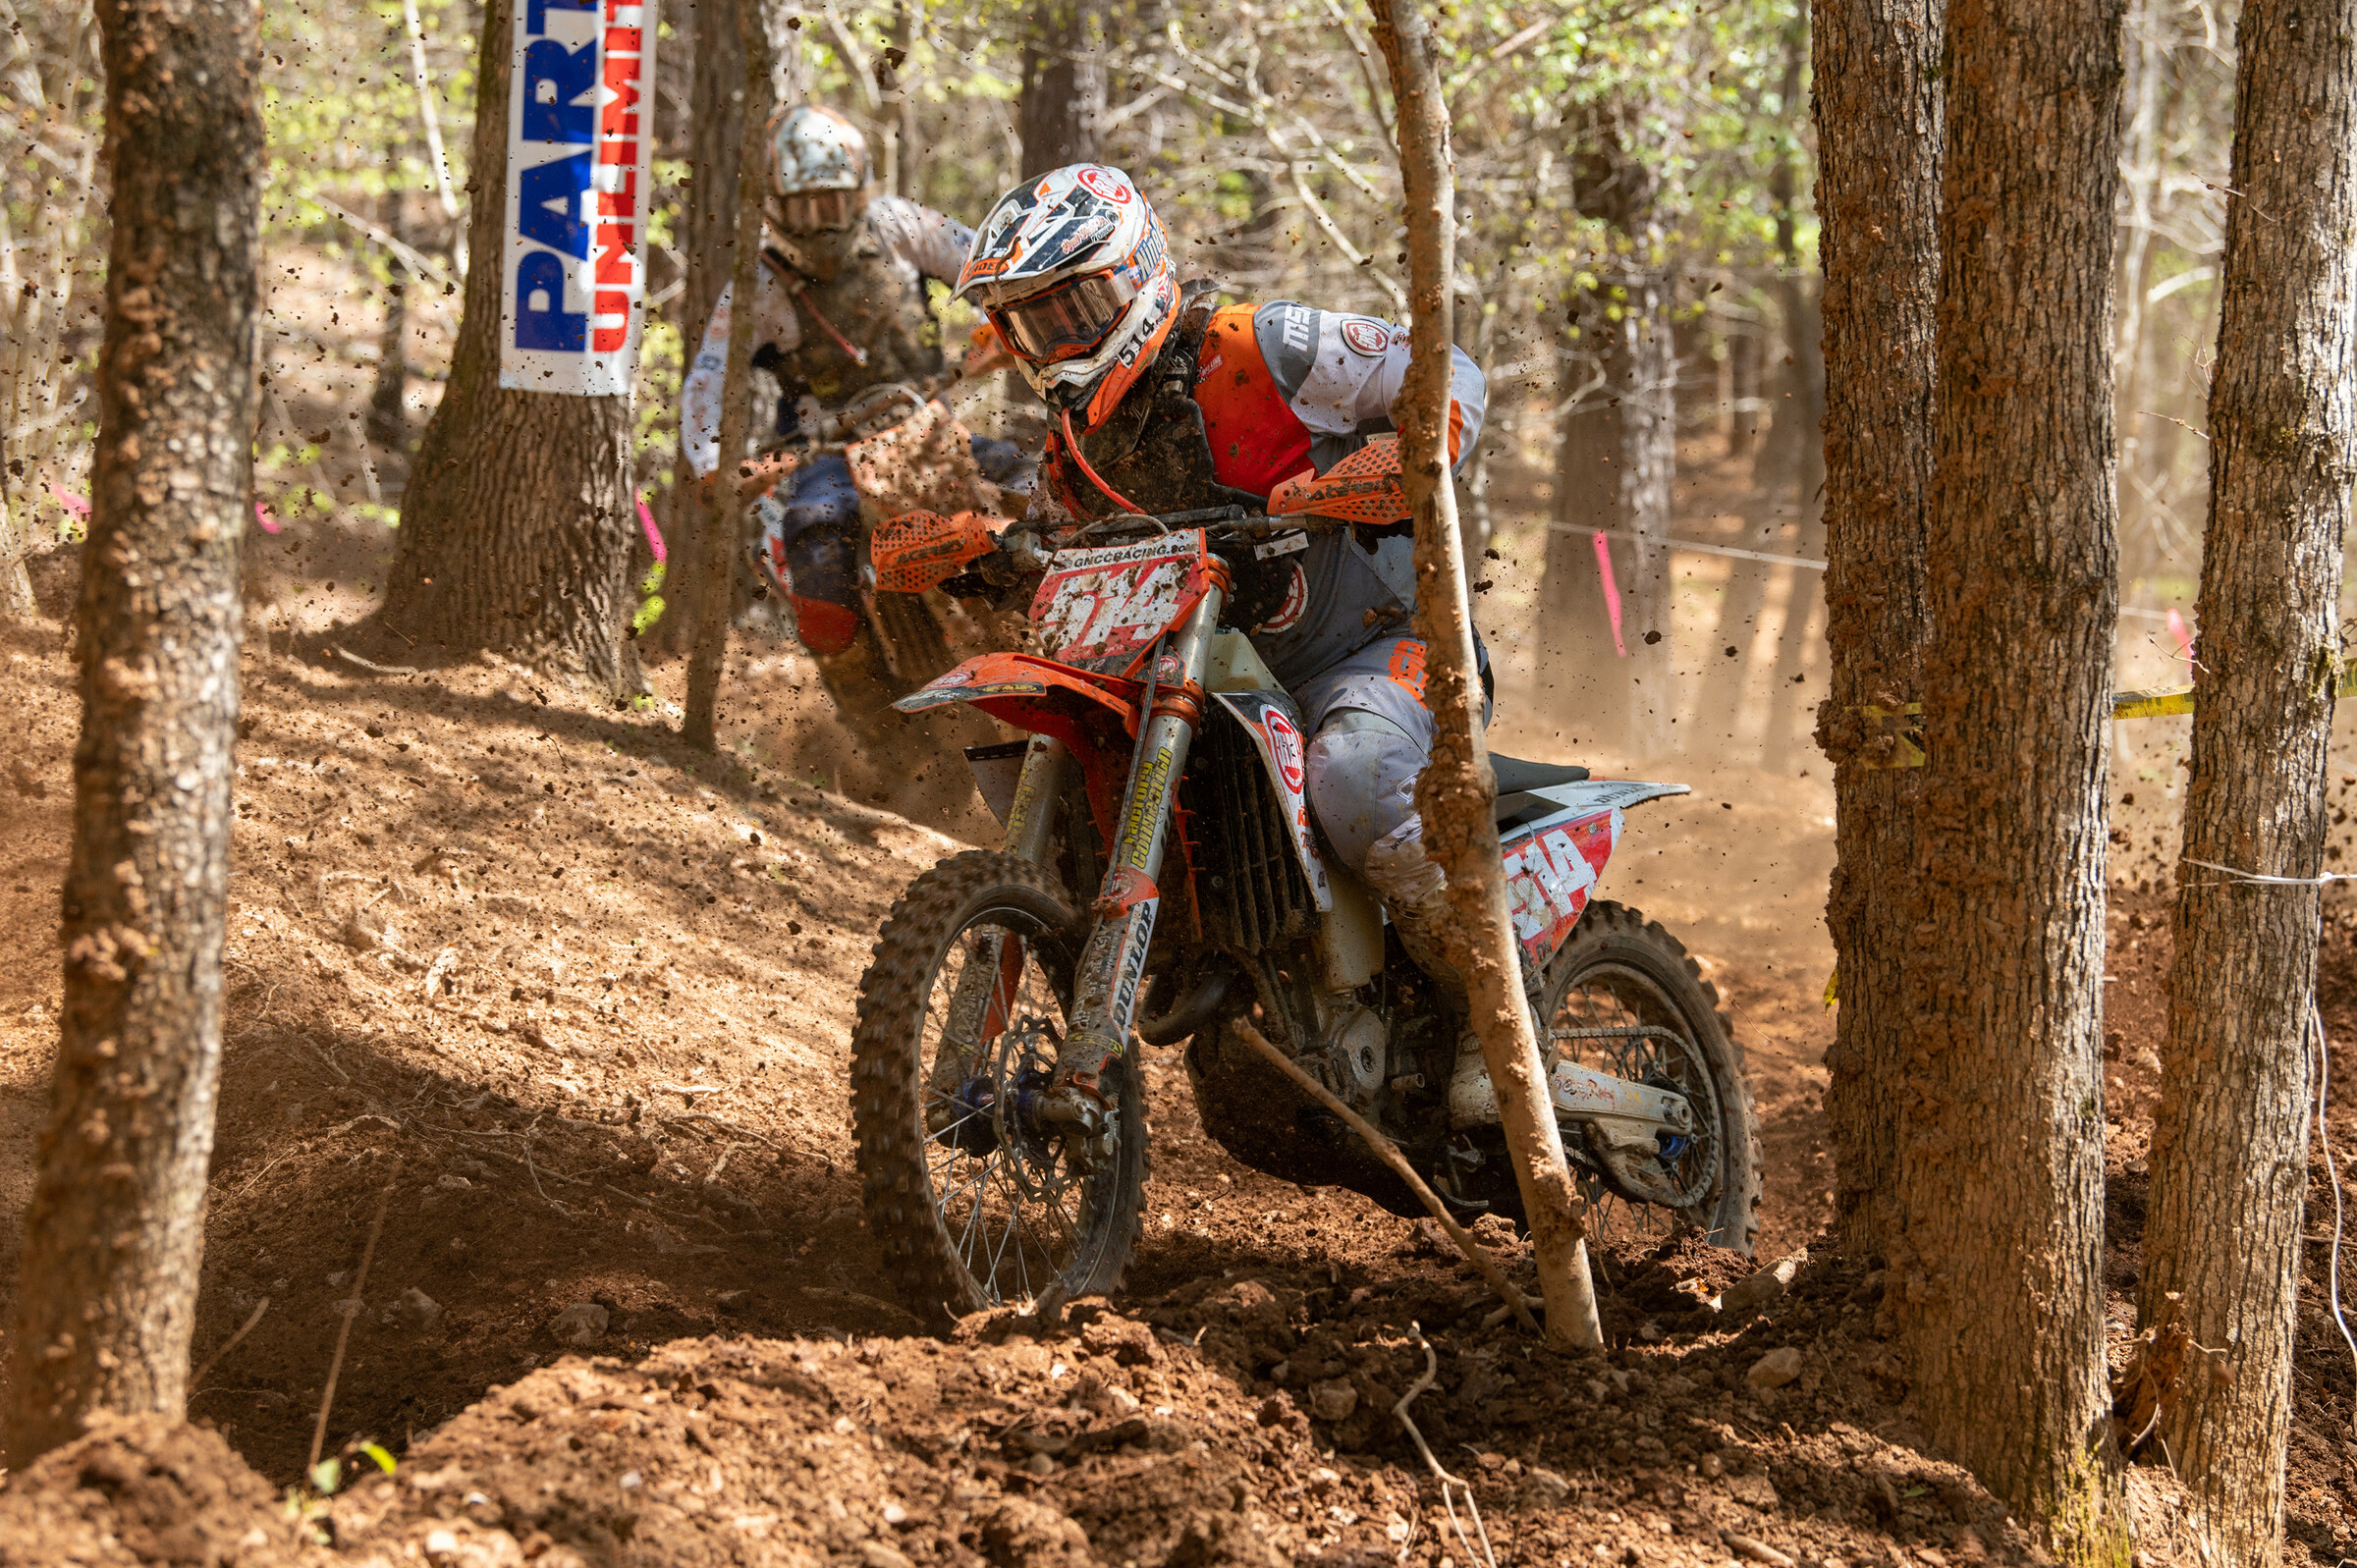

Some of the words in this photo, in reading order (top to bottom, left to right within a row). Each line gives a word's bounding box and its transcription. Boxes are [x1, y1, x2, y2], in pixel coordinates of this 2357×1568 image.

[1118, 317, 1156, 366] 514
[1037, 561, 1193, 651] 514
[1112, 900, 1153, 1027] DUNLOP
